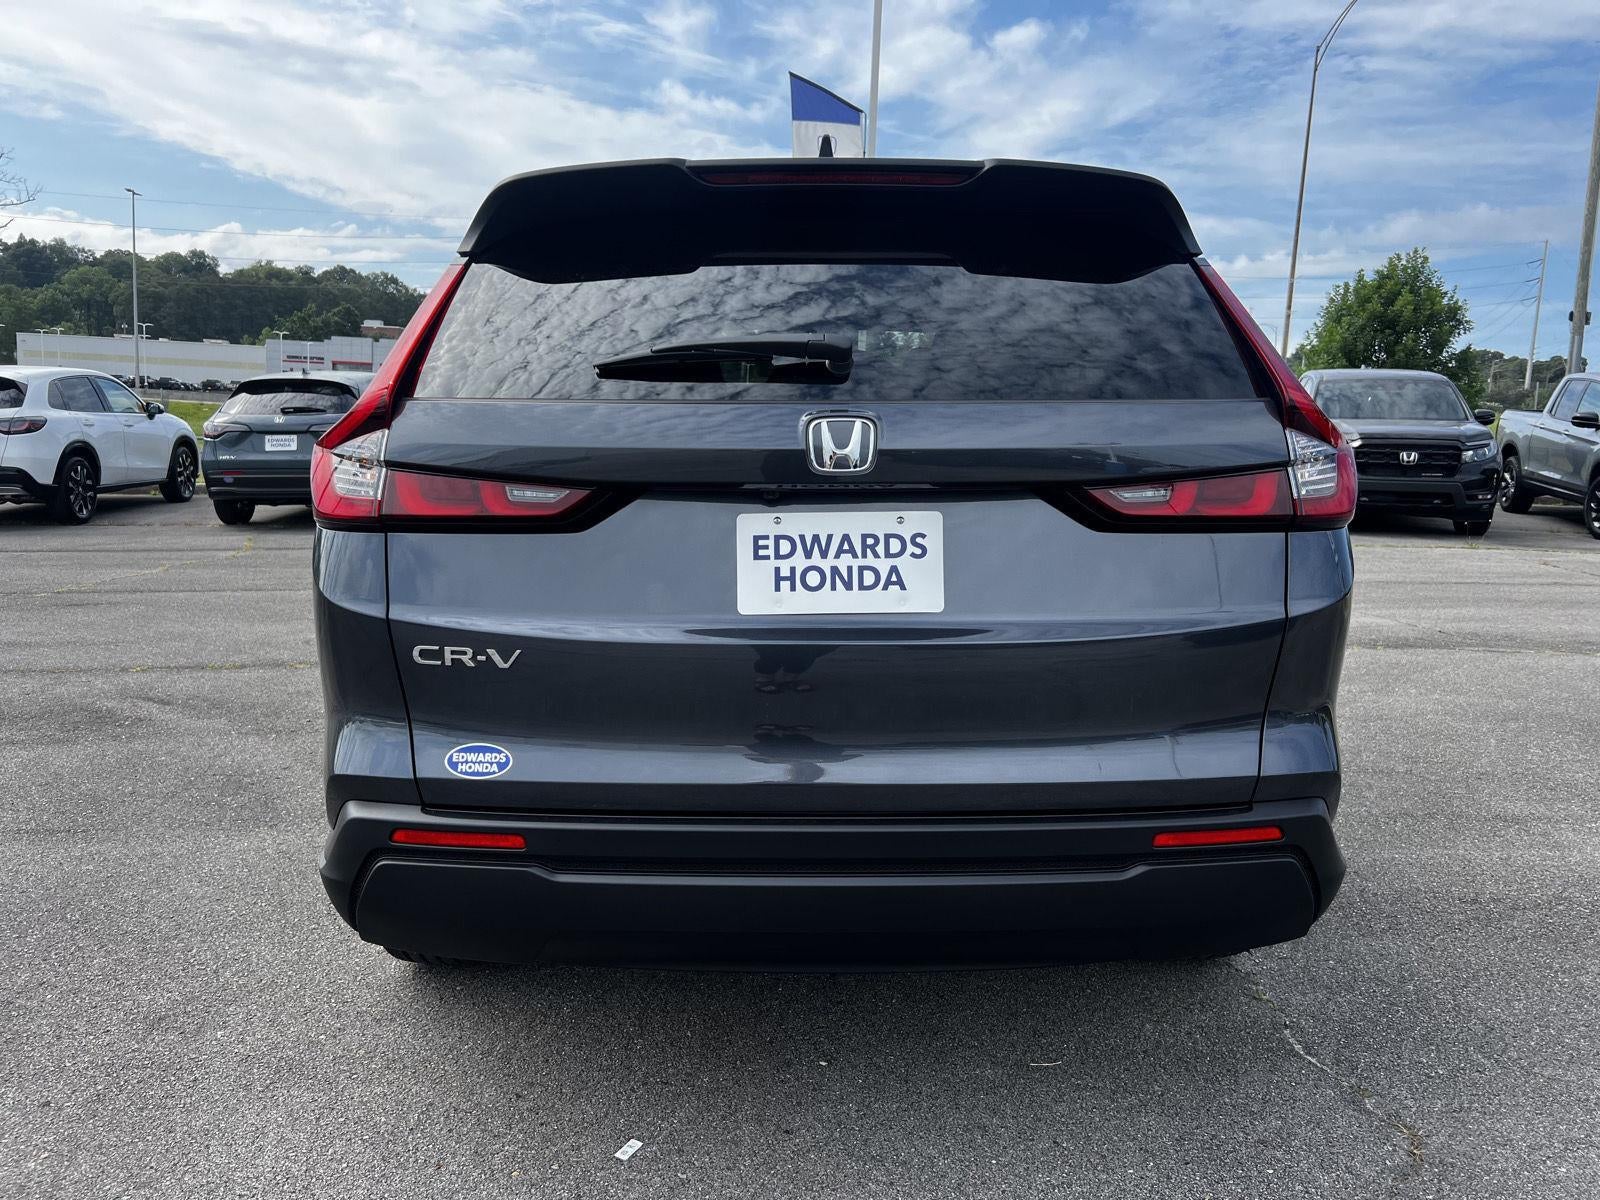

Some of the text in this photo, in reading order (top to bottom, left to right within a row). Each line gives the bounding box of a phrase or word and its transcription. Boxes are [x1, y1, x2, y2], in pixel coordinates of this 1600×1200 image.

[752, 532, 928, 561] EDWARDS
[774, 565, 907, 593] HONDA
[412, 645, 522, 669] CR-V
[452, 752, 507, 763] EDWARDS
[457, 762, 499, 773] HONDA
